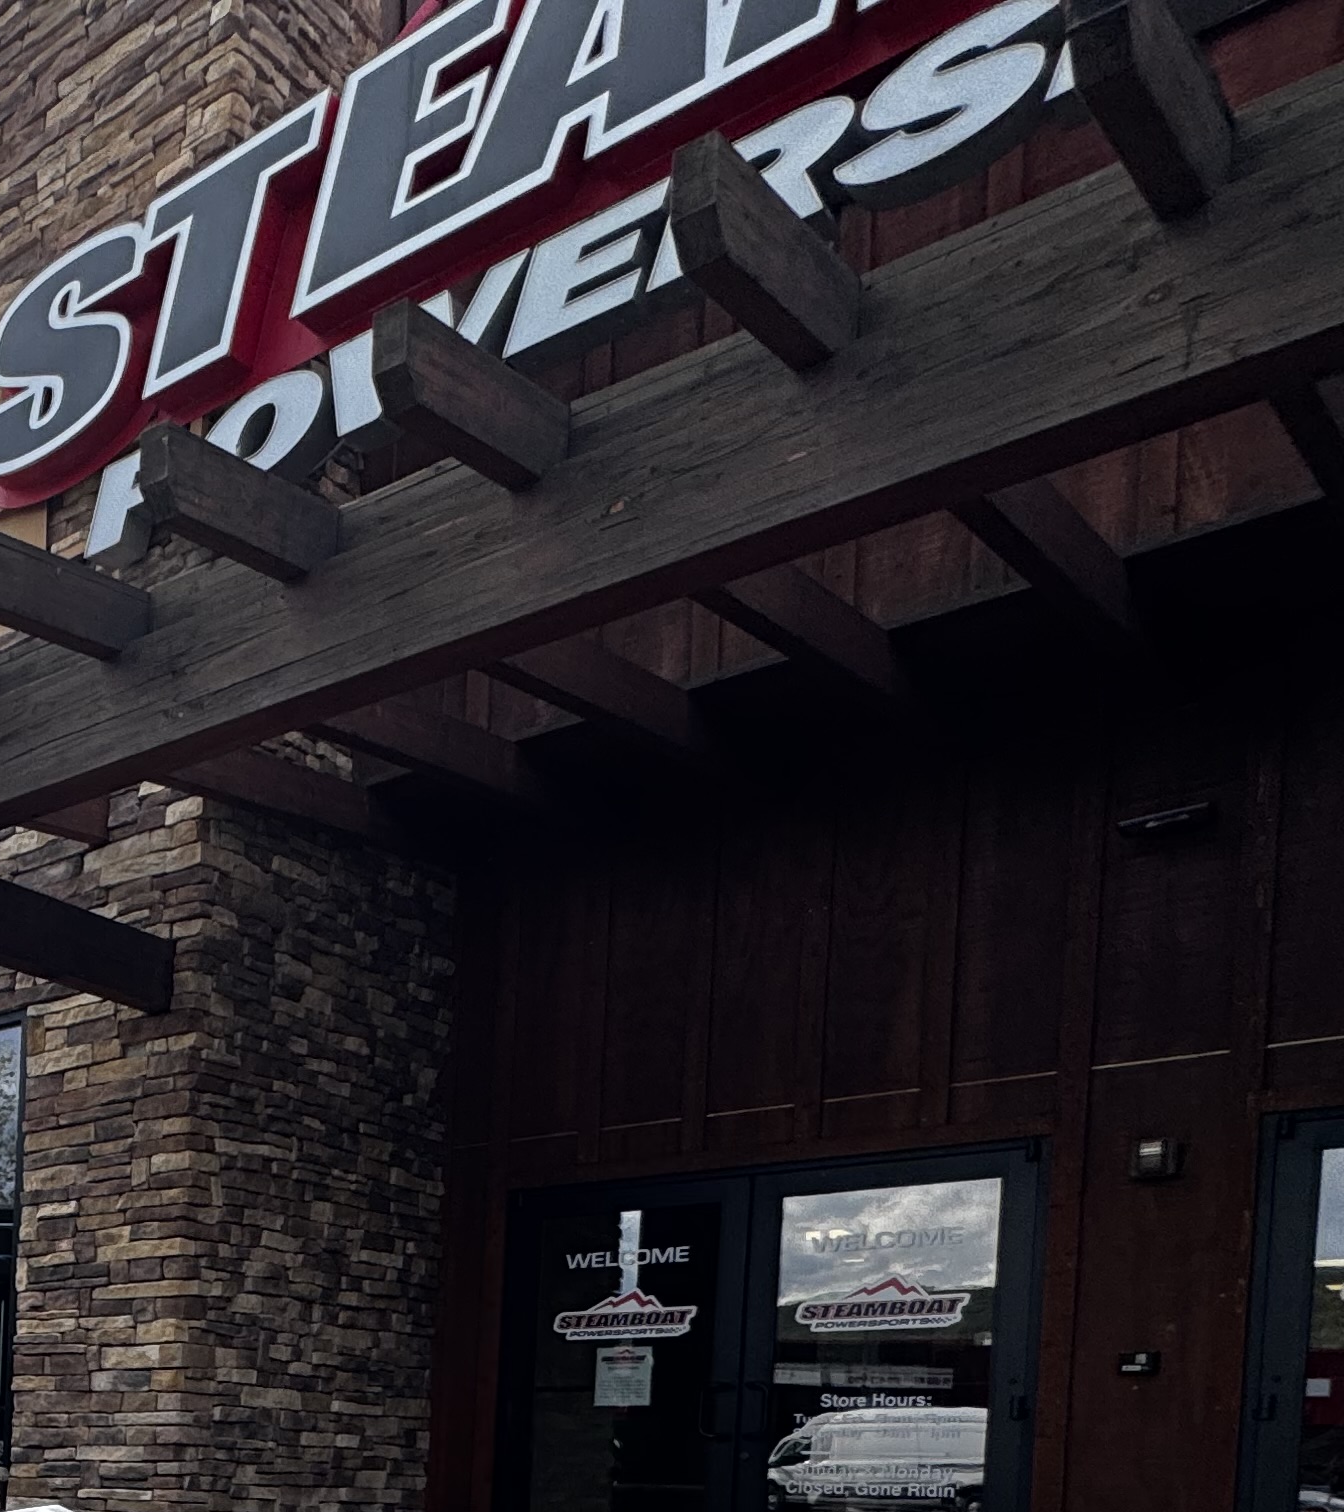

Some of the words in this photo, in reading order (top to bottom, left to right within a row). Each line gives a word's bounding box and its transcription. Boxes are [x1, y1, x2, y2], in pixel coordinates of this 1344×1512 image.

[812, 1227, 965, 1252] WELCOME
[566, 1246, 691, 1269] WELCOME
[558, 1308, 693, 1329] STEAMBOAT
[800, 1298, 965, 1320] STEAMBOAT
[569, 1327, 666, 1338] POWERSPORTS
[813, 1317, 931, 1329] POWERSPORTS
[820, 1393, 867, 1408] Store
[872, 1392, 932, 1408] Hours:
[883, 1464, 954, 1482] Monday
[786, 1480, 849, 1499] Closed,
[855, 1483, 901, 1497] Gone
